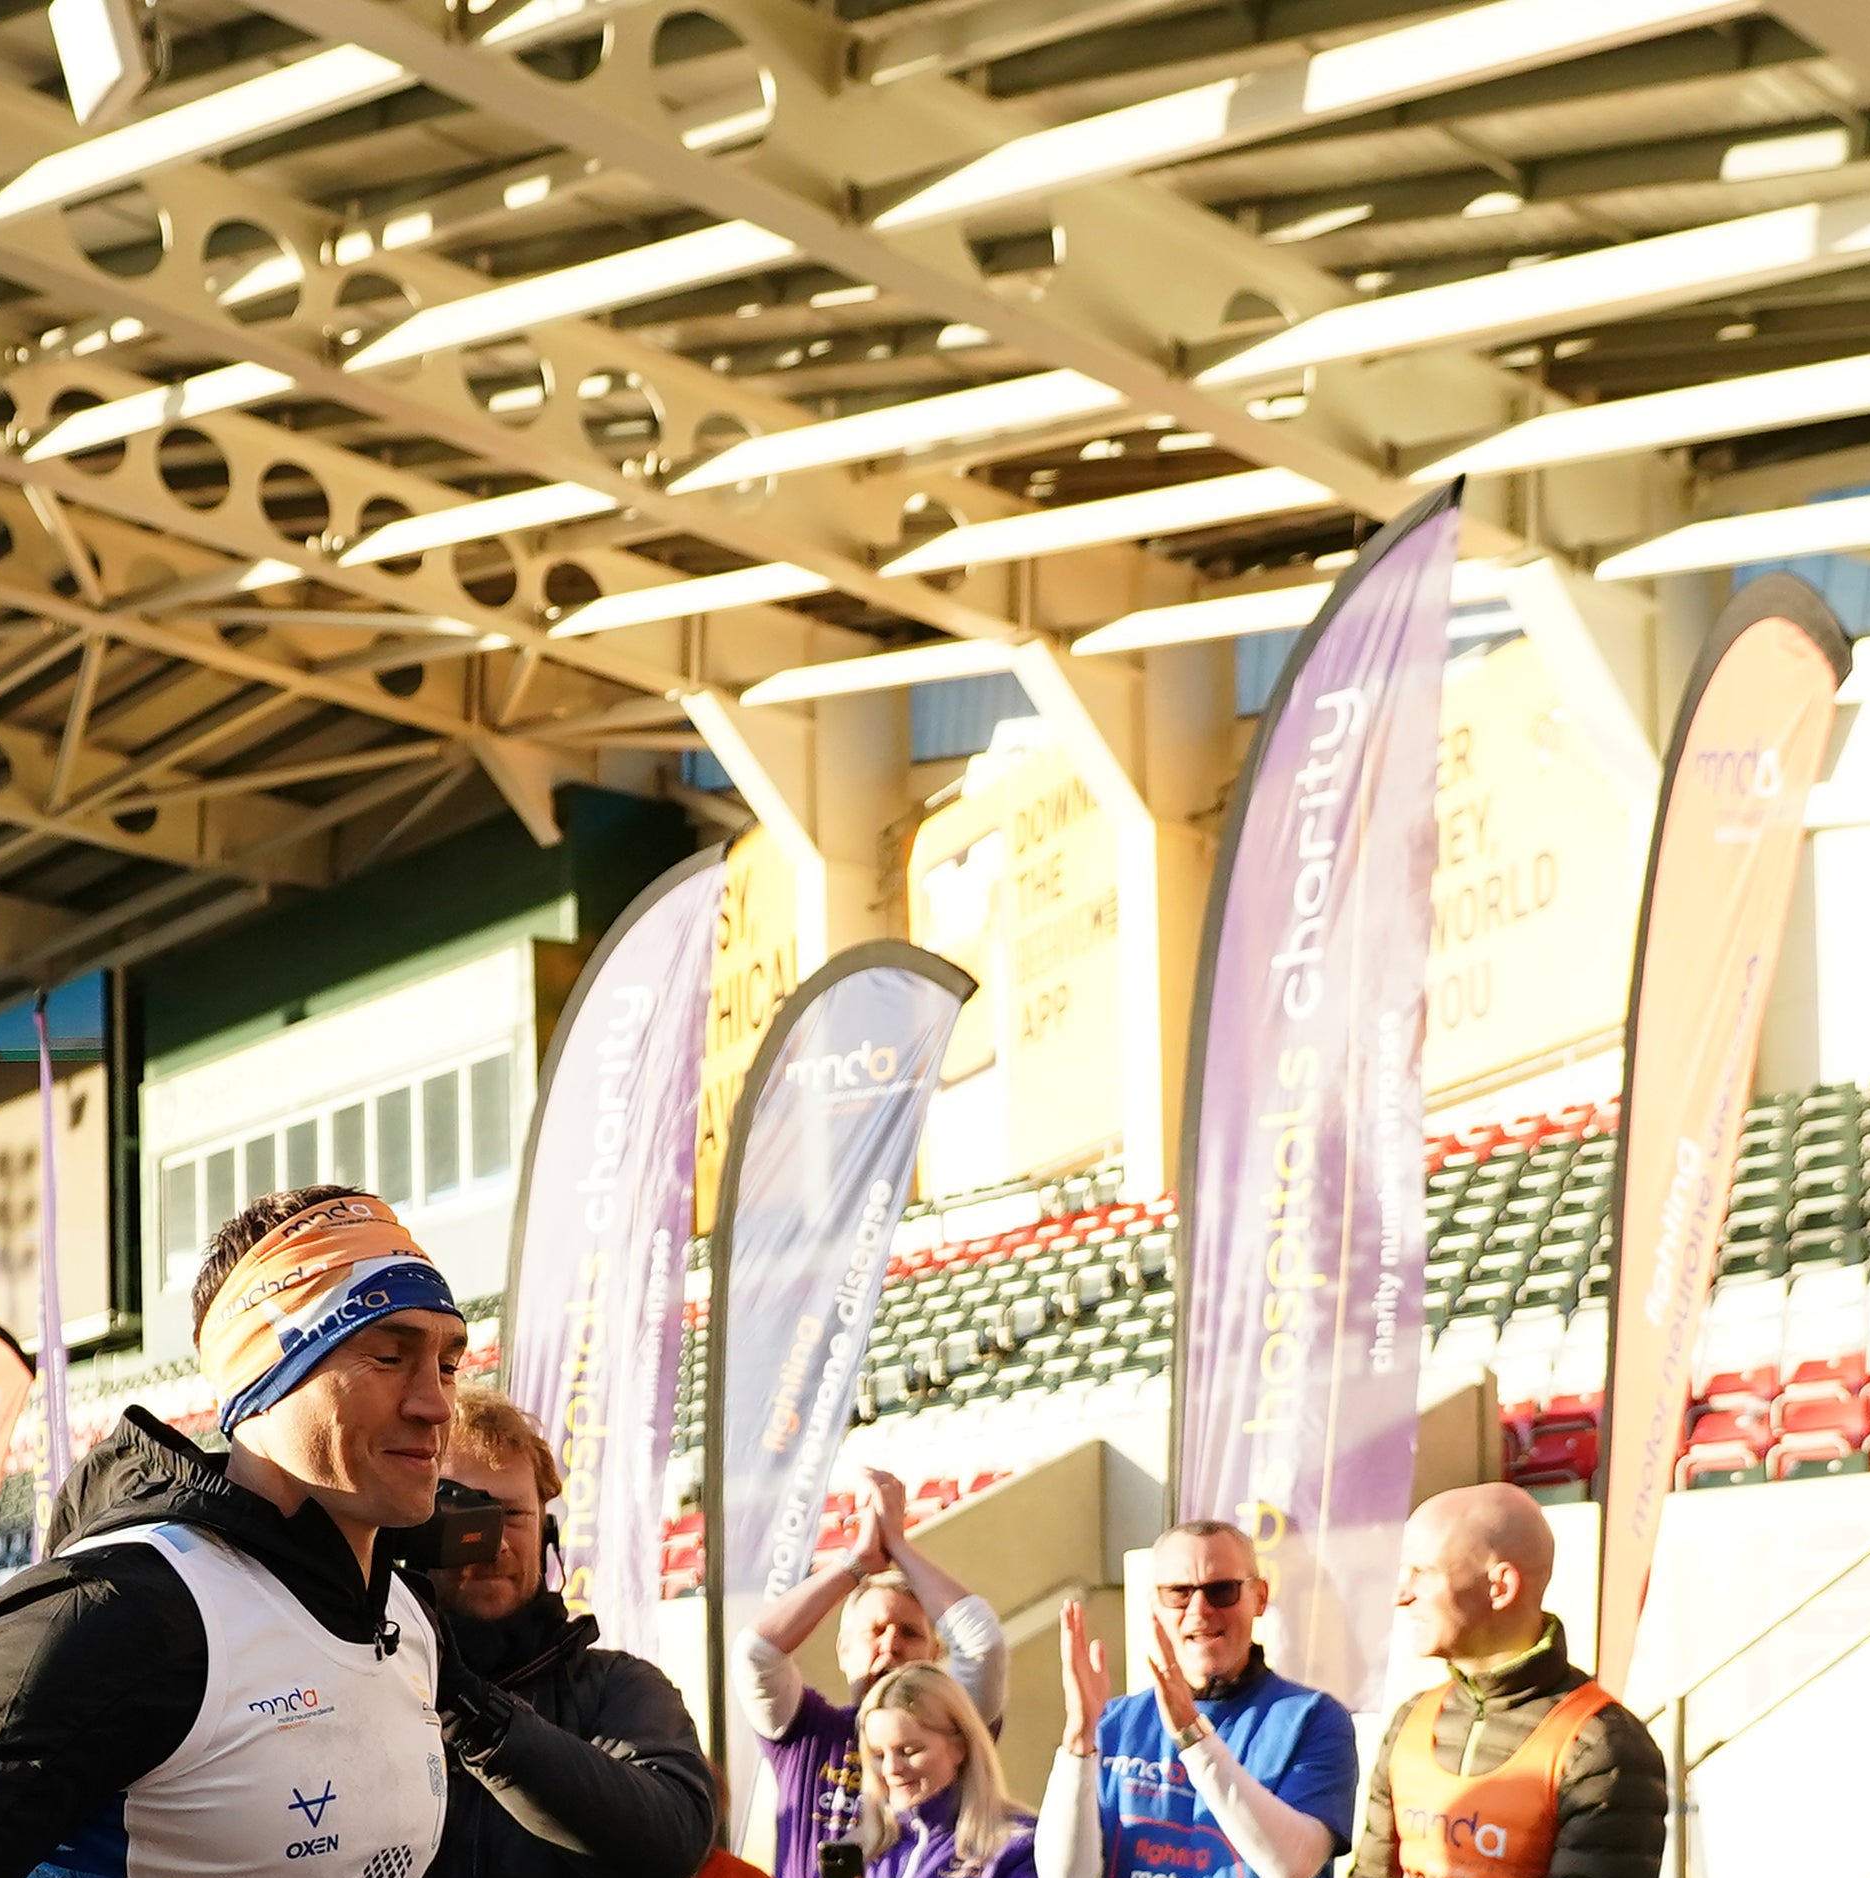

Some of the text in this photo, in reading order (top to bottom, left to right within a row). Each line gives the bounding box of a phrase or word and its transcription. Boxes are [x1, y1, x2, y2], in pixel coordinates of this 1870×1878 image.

[1434, 724, 1474, 793] ER
[1271, 685, 1368, 1021] charity
[1019, 982, 1069, 1050] APP
[581, 983, 653, 1233] charity
[282, 1200, 374, 1240] mnda
[1242, 1046, 1324, 1434] hospitals
[1366, 1271, 1398, 1374] charity
[559, 1250, 610, 1547] hospitals
[762, 1314, 823, 1453] fighting
[763, 1494, 810, 1603] motor
[791, 1332, 852, 1490] neurone
[834, 1178, 893, 1330] disease
[249, 1687, 318, 1715] mnda
[286, 1833, 339, 1859] OXEN
[1403, 1808, 1508, 1859] mnda
